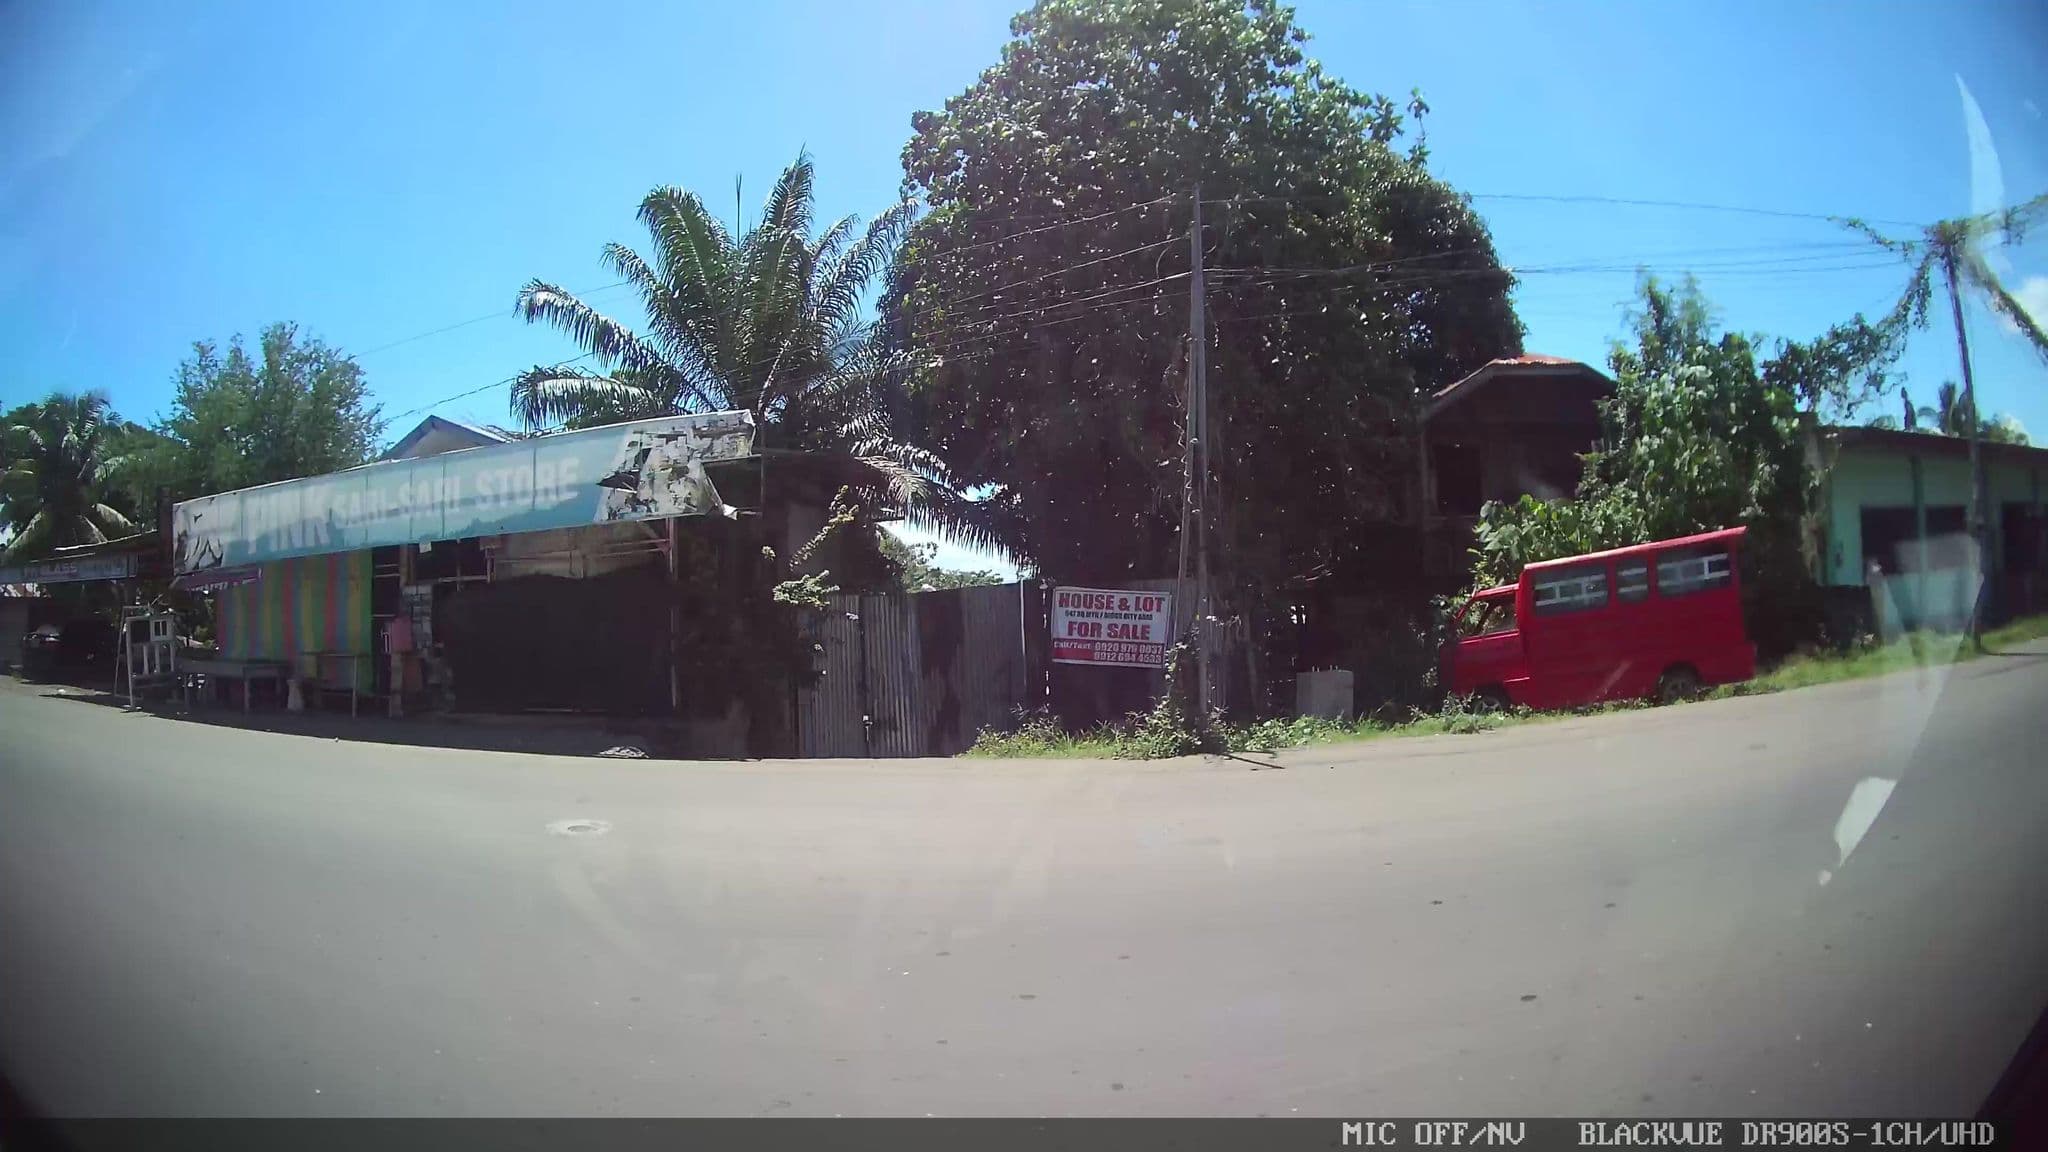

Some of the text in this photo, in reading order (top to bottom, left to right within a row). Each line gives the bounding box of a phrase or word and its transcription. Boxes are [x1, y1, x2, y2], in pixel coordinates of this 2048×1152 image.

[475, 457, 580, 510] STORE
[1058, 592, 1166, 613] HOUSE & LOT
[1067, 620, 1151, 640] FOR SALE
